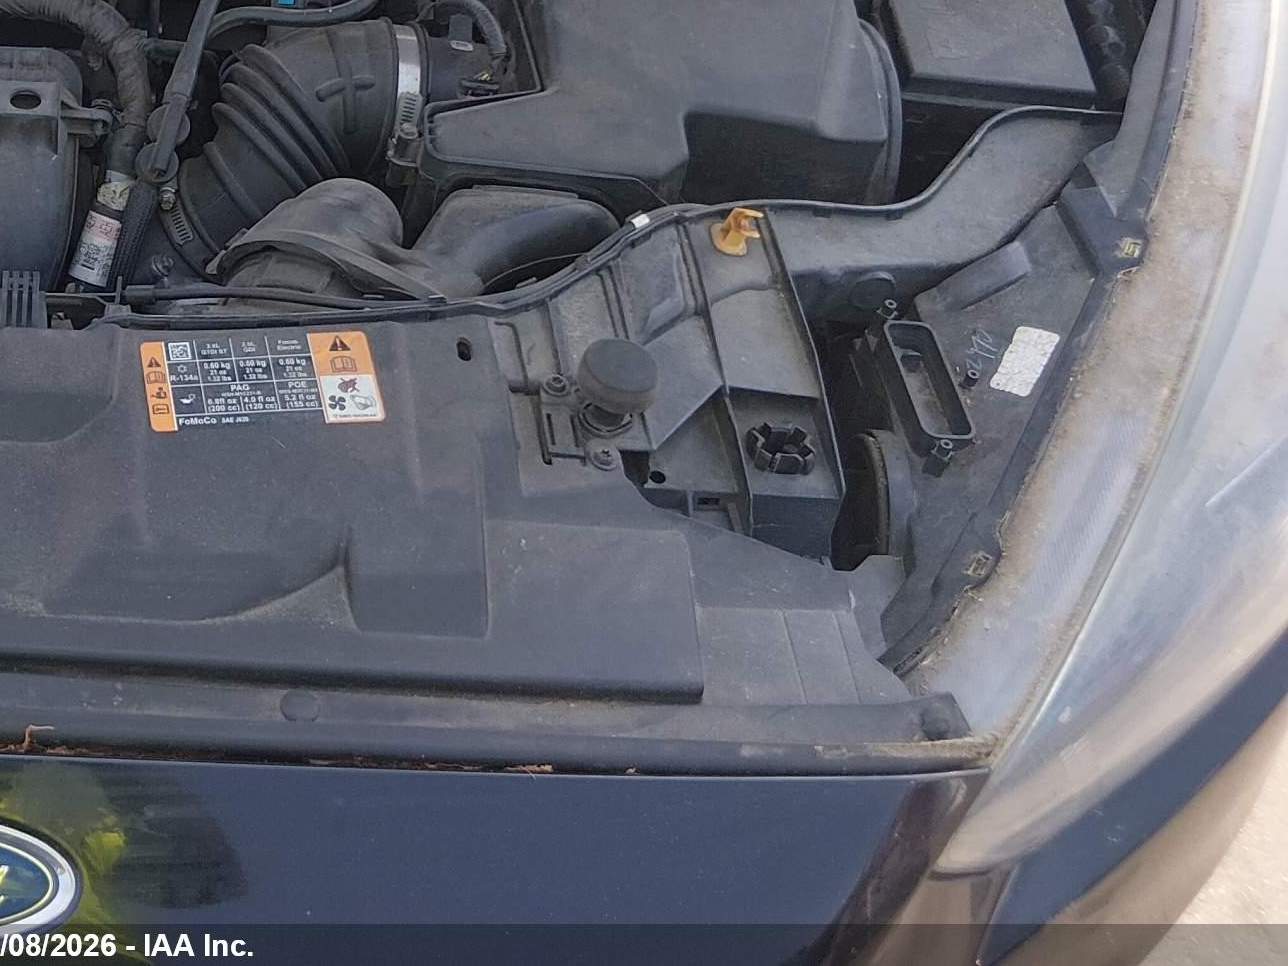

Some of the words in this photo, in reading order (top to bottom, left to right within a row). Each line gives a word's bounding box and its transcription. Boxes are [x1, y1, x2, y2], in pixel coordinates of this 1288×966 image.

[220, 361, 231, 370] kg
[255, 359, 267, 368] kg
[295, 357, 306, 366] kg
[170, 374, 199, 382] R-134a
[230, 383, 251, 392] PAG
[288, 380, 307, 388] POE
[227, 403, 240, 411] cc)
[245, 402, 263, 411] (120
[264, 401, 278, 410] cc)
[305, 400, 319, 409] cc)
[179, 416, 218, 426] FoMoCo
